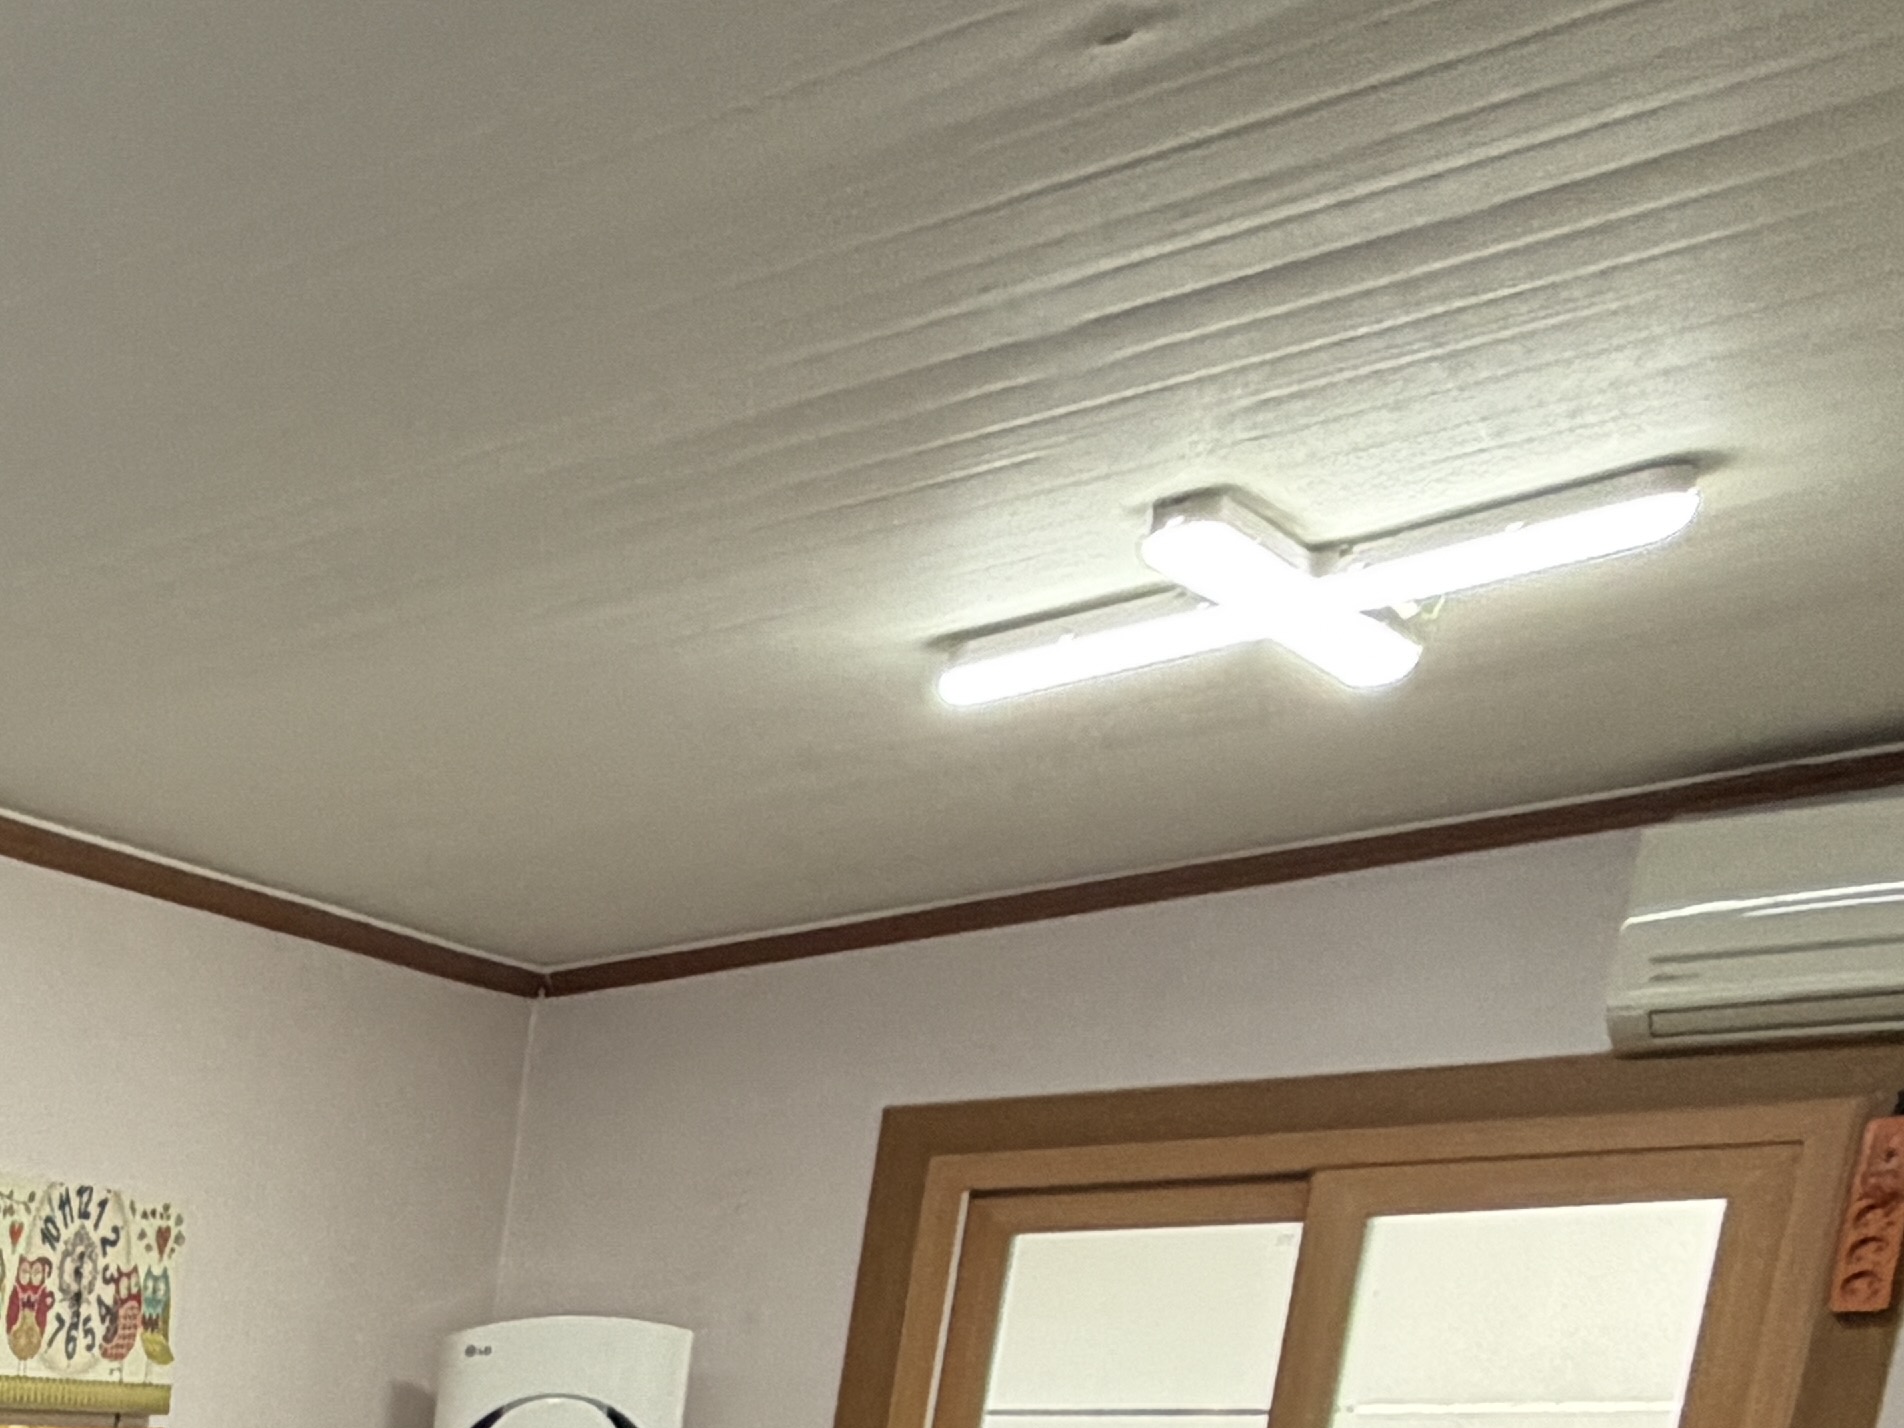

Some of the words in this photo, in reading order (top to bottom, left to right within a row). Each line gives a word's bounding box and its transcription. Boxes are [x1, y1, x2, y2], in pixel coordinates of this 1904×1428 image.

[59, 1187, 73, 1229] 11
[76, 1185, 93, 1220] 12
[94, 1197, 109, 1231] 1
[41, 1215, 60, 1251] 10
[100, 1225, 119, 1257] 2
[47, 1312, 65, 1349] 7
[82, 1314, 96, 1352] 5
